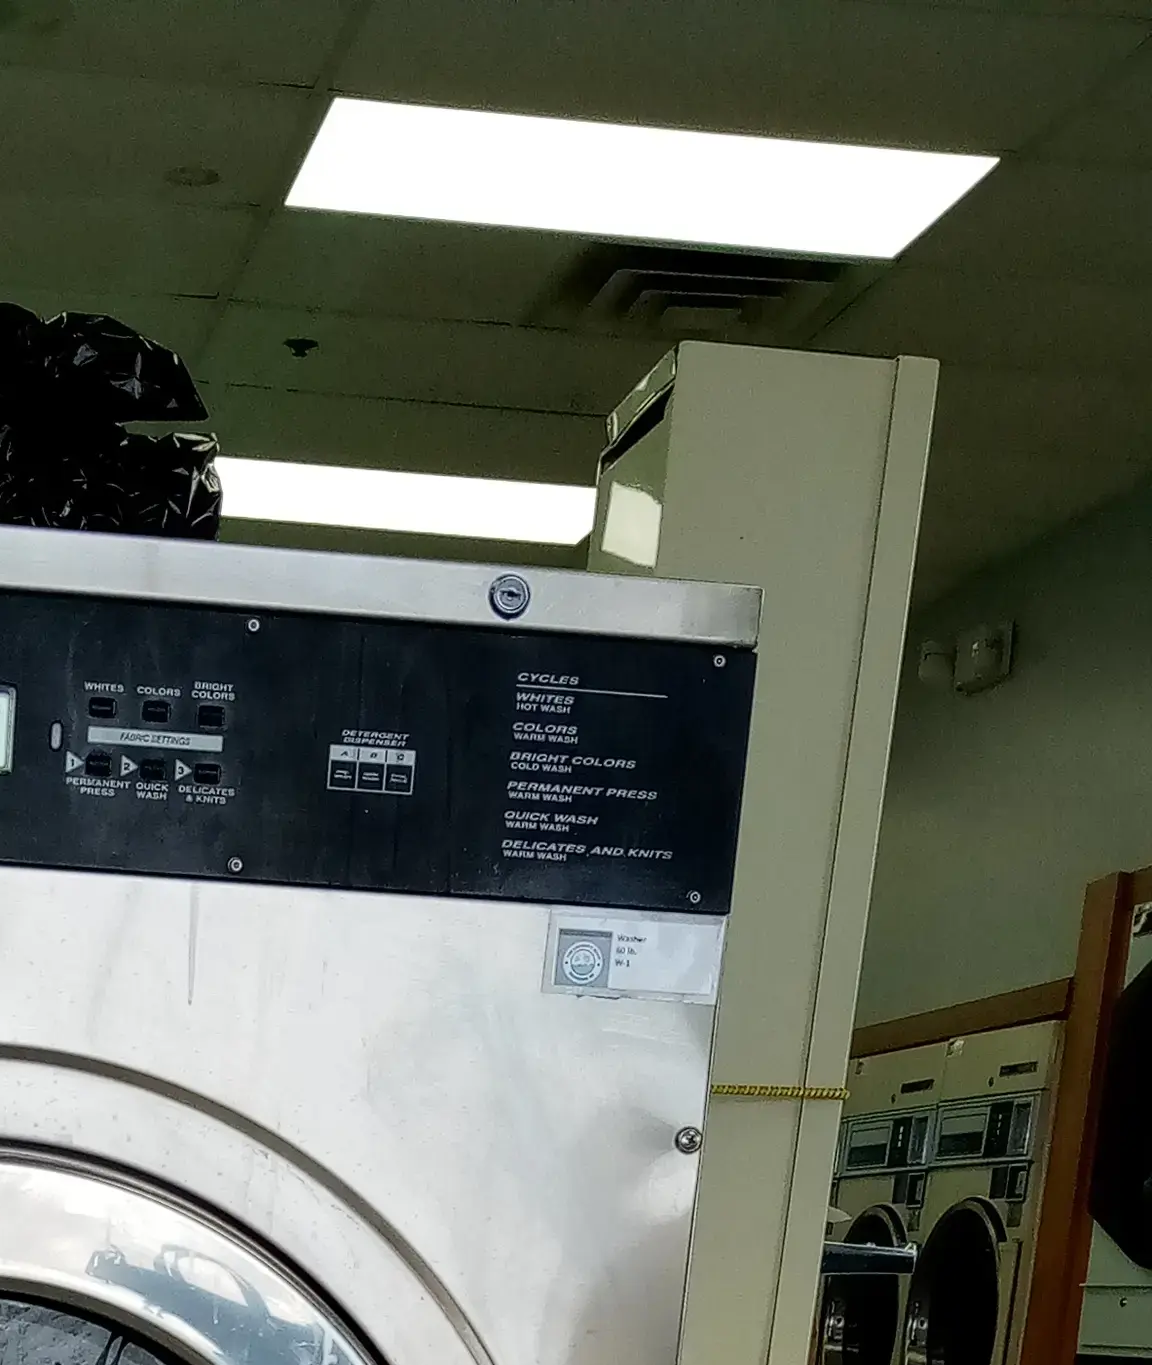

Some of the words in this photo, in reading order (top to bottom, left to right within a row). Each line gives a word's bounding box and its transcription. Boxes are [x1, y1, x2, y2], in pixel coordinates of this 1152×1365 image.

[518, 672, 580, 685] CYCLES
[84, 681, 124, 693] WHITES
[136, 686, 182, 698] COLORS
[194, 681, 234, 692] BRIGHT
[192, 690, 236, 701] COLORS
[516, 692, 575, 705] WHITES
[516, 702, 538, 711] HOT
[540, 704, 571, 714] WASH
[342, 729, 410, 740] DETERGENT
[512, 722, 578, 735] COLORS
[120, 732, 148, 743] FABRIC
[150, 734, 192, 746] SETTINGS
[343, 737, 406, 746] DISPENSER
[514, 732, 546, 742] WARM
[548, 734, 578, 744] WASH
[70, 758, 75, 766] 1
[123, 762, 130, 771] 2
[510, 752, 569, 764] BRIGHT
[571, 756, 636, 770] COLORS
[178, 766, 184, 775] 3
[510, 762, 540, 772] COLD
[542, 764, 572, 774] WASH
[66, 776, 132, 789] PERMANENT
[136, 782, 170, 792] QUICK
[80, 787, 116, 797] PRESS
[136, 790, 168, 800] WASH
[178, 784, 235, 797] DELICATES
[506, 780, 604, 796] PERMANENT
[606, 787, 658, 800] PRESS
[196, 796, 226, 805] KNITS
[508, 791, 540, 800] WARM
[542, 793, 572, 802] WASH
[504, 810, 551, 822] QUICK
[554, 813, 599, 825] WASH
[504, 820, 538, 830] WARM
[540, 822, 570, 832] WASH
[501, 839, 586, 854] DELICATES
[590, 846, 624, 856] AND
[627, 848, 674, 860] KNITS
[502, 850, 535, 858] WARM
[536, 852, 567, 862] WASH
[617, 934, 647, 942] Washer
